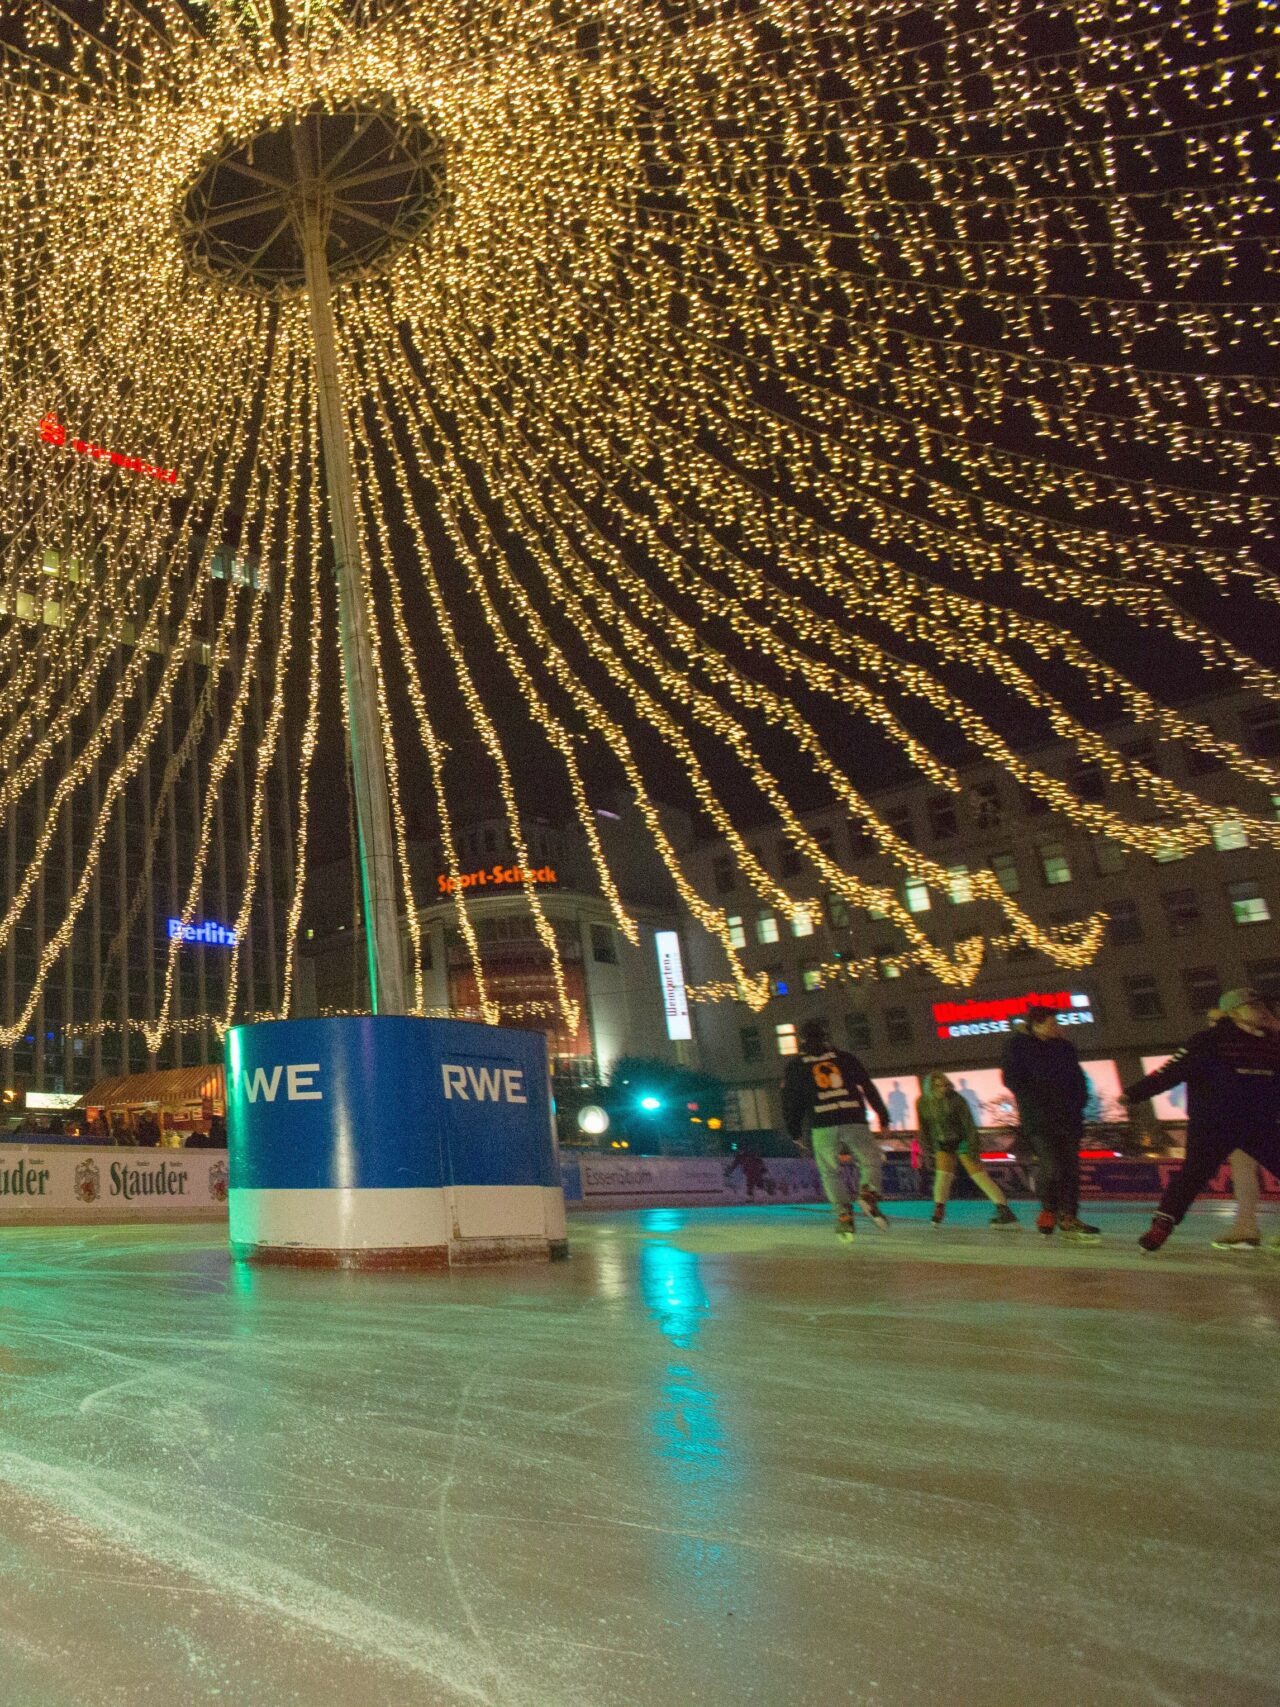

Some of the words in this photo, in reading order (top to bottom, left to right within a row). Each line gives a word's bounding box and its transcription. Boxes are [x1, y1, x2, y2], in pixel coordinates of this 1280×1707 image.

[167, 918, 238, 946] Berlitz
[949, 1020, 1012, 1038] GROSSE
[442, 1064, 528, 1104] RWE
[109, 1161, 188, 1201] Stauder
